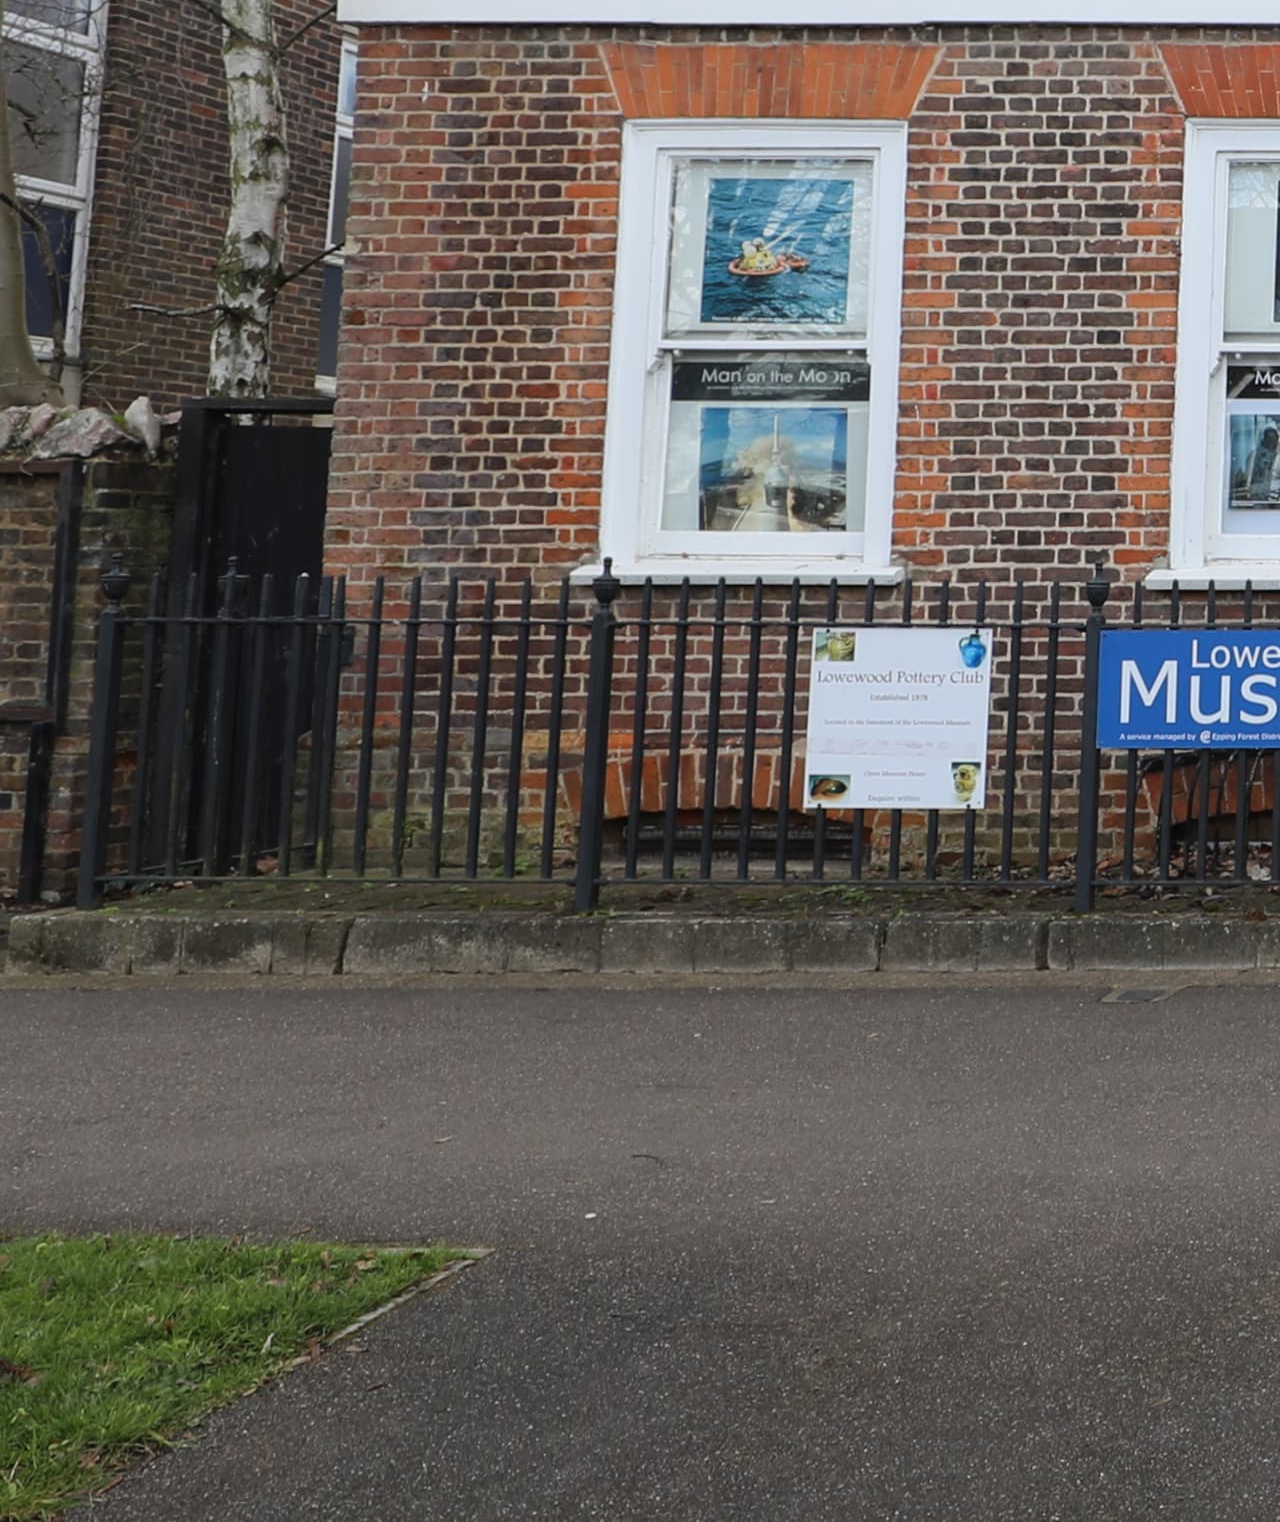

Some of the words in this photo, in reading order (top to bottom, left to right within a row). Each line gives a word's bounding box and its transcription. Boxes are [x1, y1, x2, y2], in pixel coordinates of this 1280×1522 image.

[701, 368, 742, 383] Man
[747, 372, 766, 383] on
[770, 370, 793, 383] the
[817, 670, 893, 684] Lowewood
[897, 671, 946, 686] Pottery
[950, 671, 984, 684] Club
[1119, 733, 1126, 741] A
[1127, 733, 1151, 741] service
[1153, 733, 1186, 742] managed
[1187, 733, 1196, 743] by
[1212, 733, 1236, 742] Epping
[1238, 733, 1260, 741] Forest
